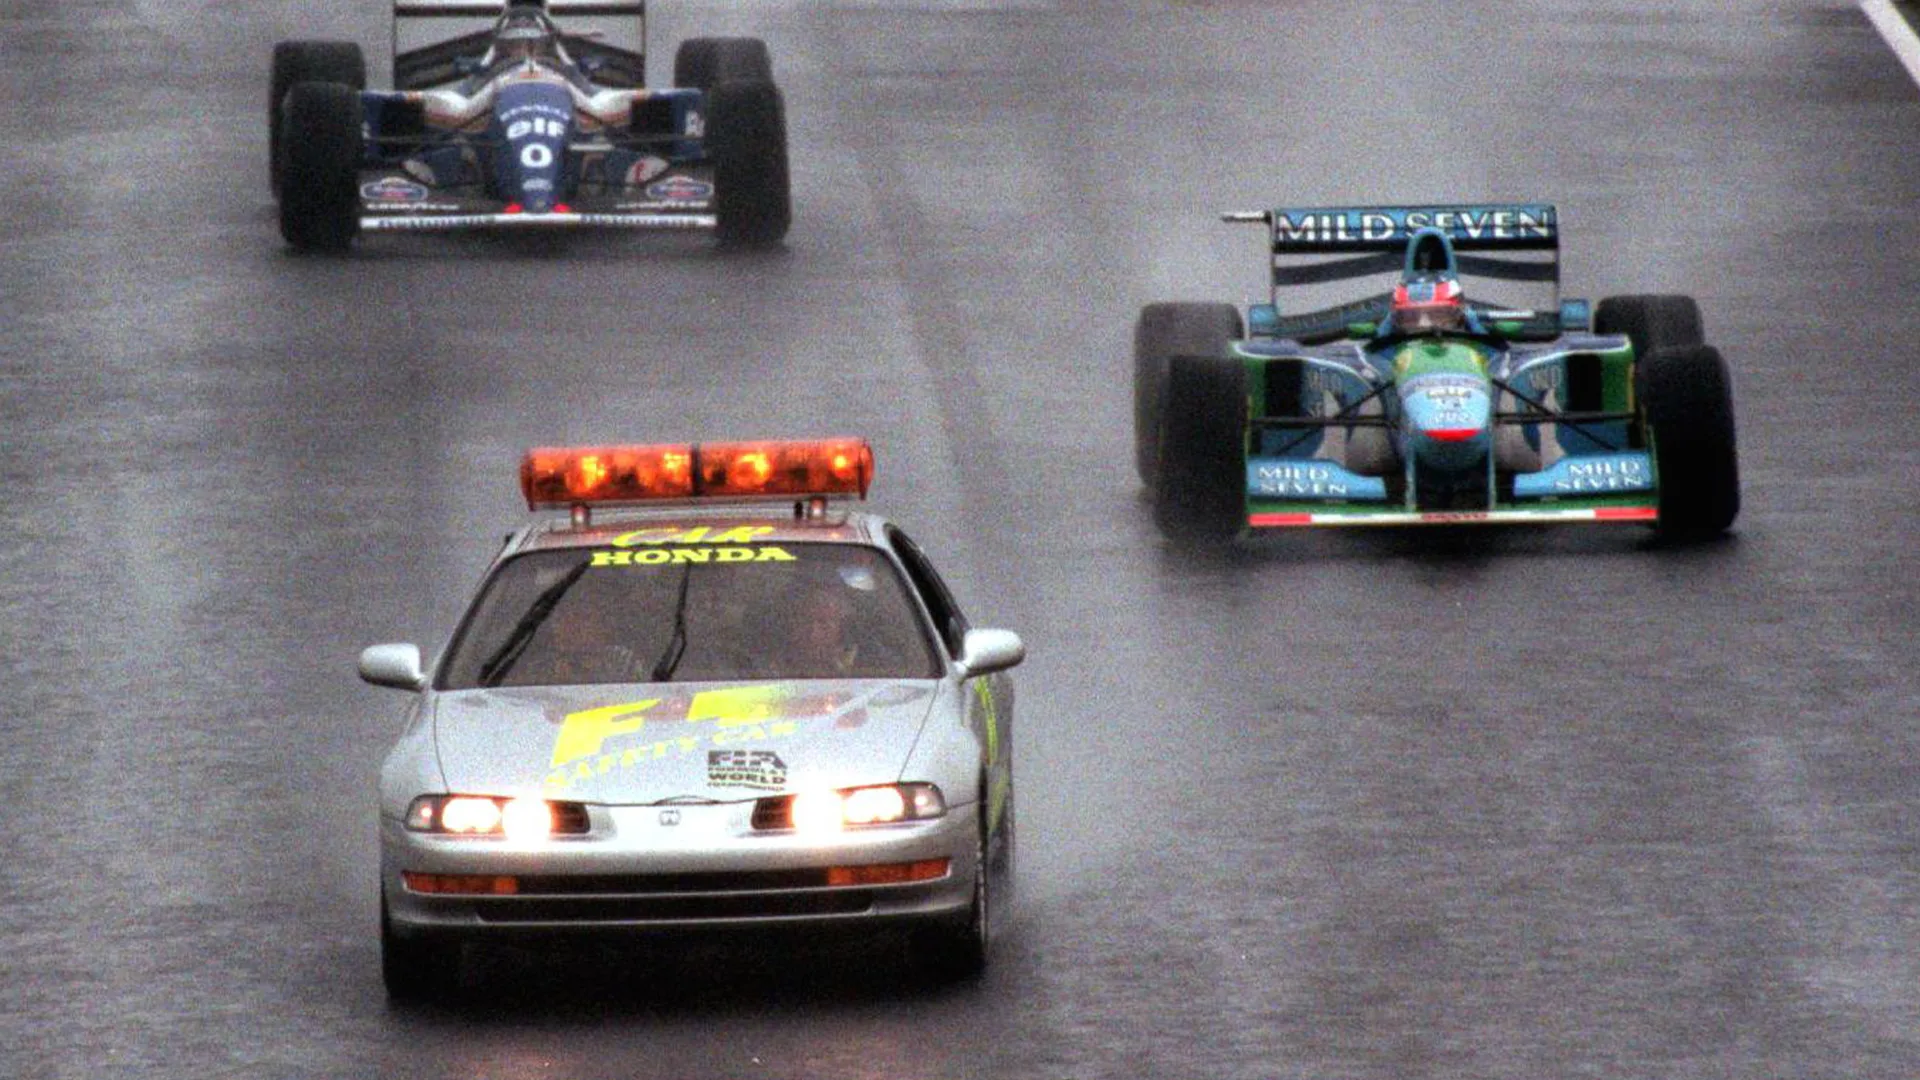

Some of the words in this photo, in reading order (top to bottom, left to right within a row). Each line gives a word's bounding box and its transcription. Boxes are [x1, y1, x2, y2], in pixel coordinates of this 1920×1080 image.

[521, 143, 553, 168] 0
[1278, 213, 1394, 241] MILD
[1405, 211, 1549, 238] SEVEN
[1259, 466, 1329, 480] MILD
[1569, 460, 1641, 475] MILD
[1259, 483, 1346, 495] SEVEN
[1554, 476, 1645, 490] SEVEN
[611, 526, 775, 546] CAR
[590, 546, 797, 567] HONDA
[708, 750, 787, 769] FIA
[708, 773, 786, 784] WORLD
